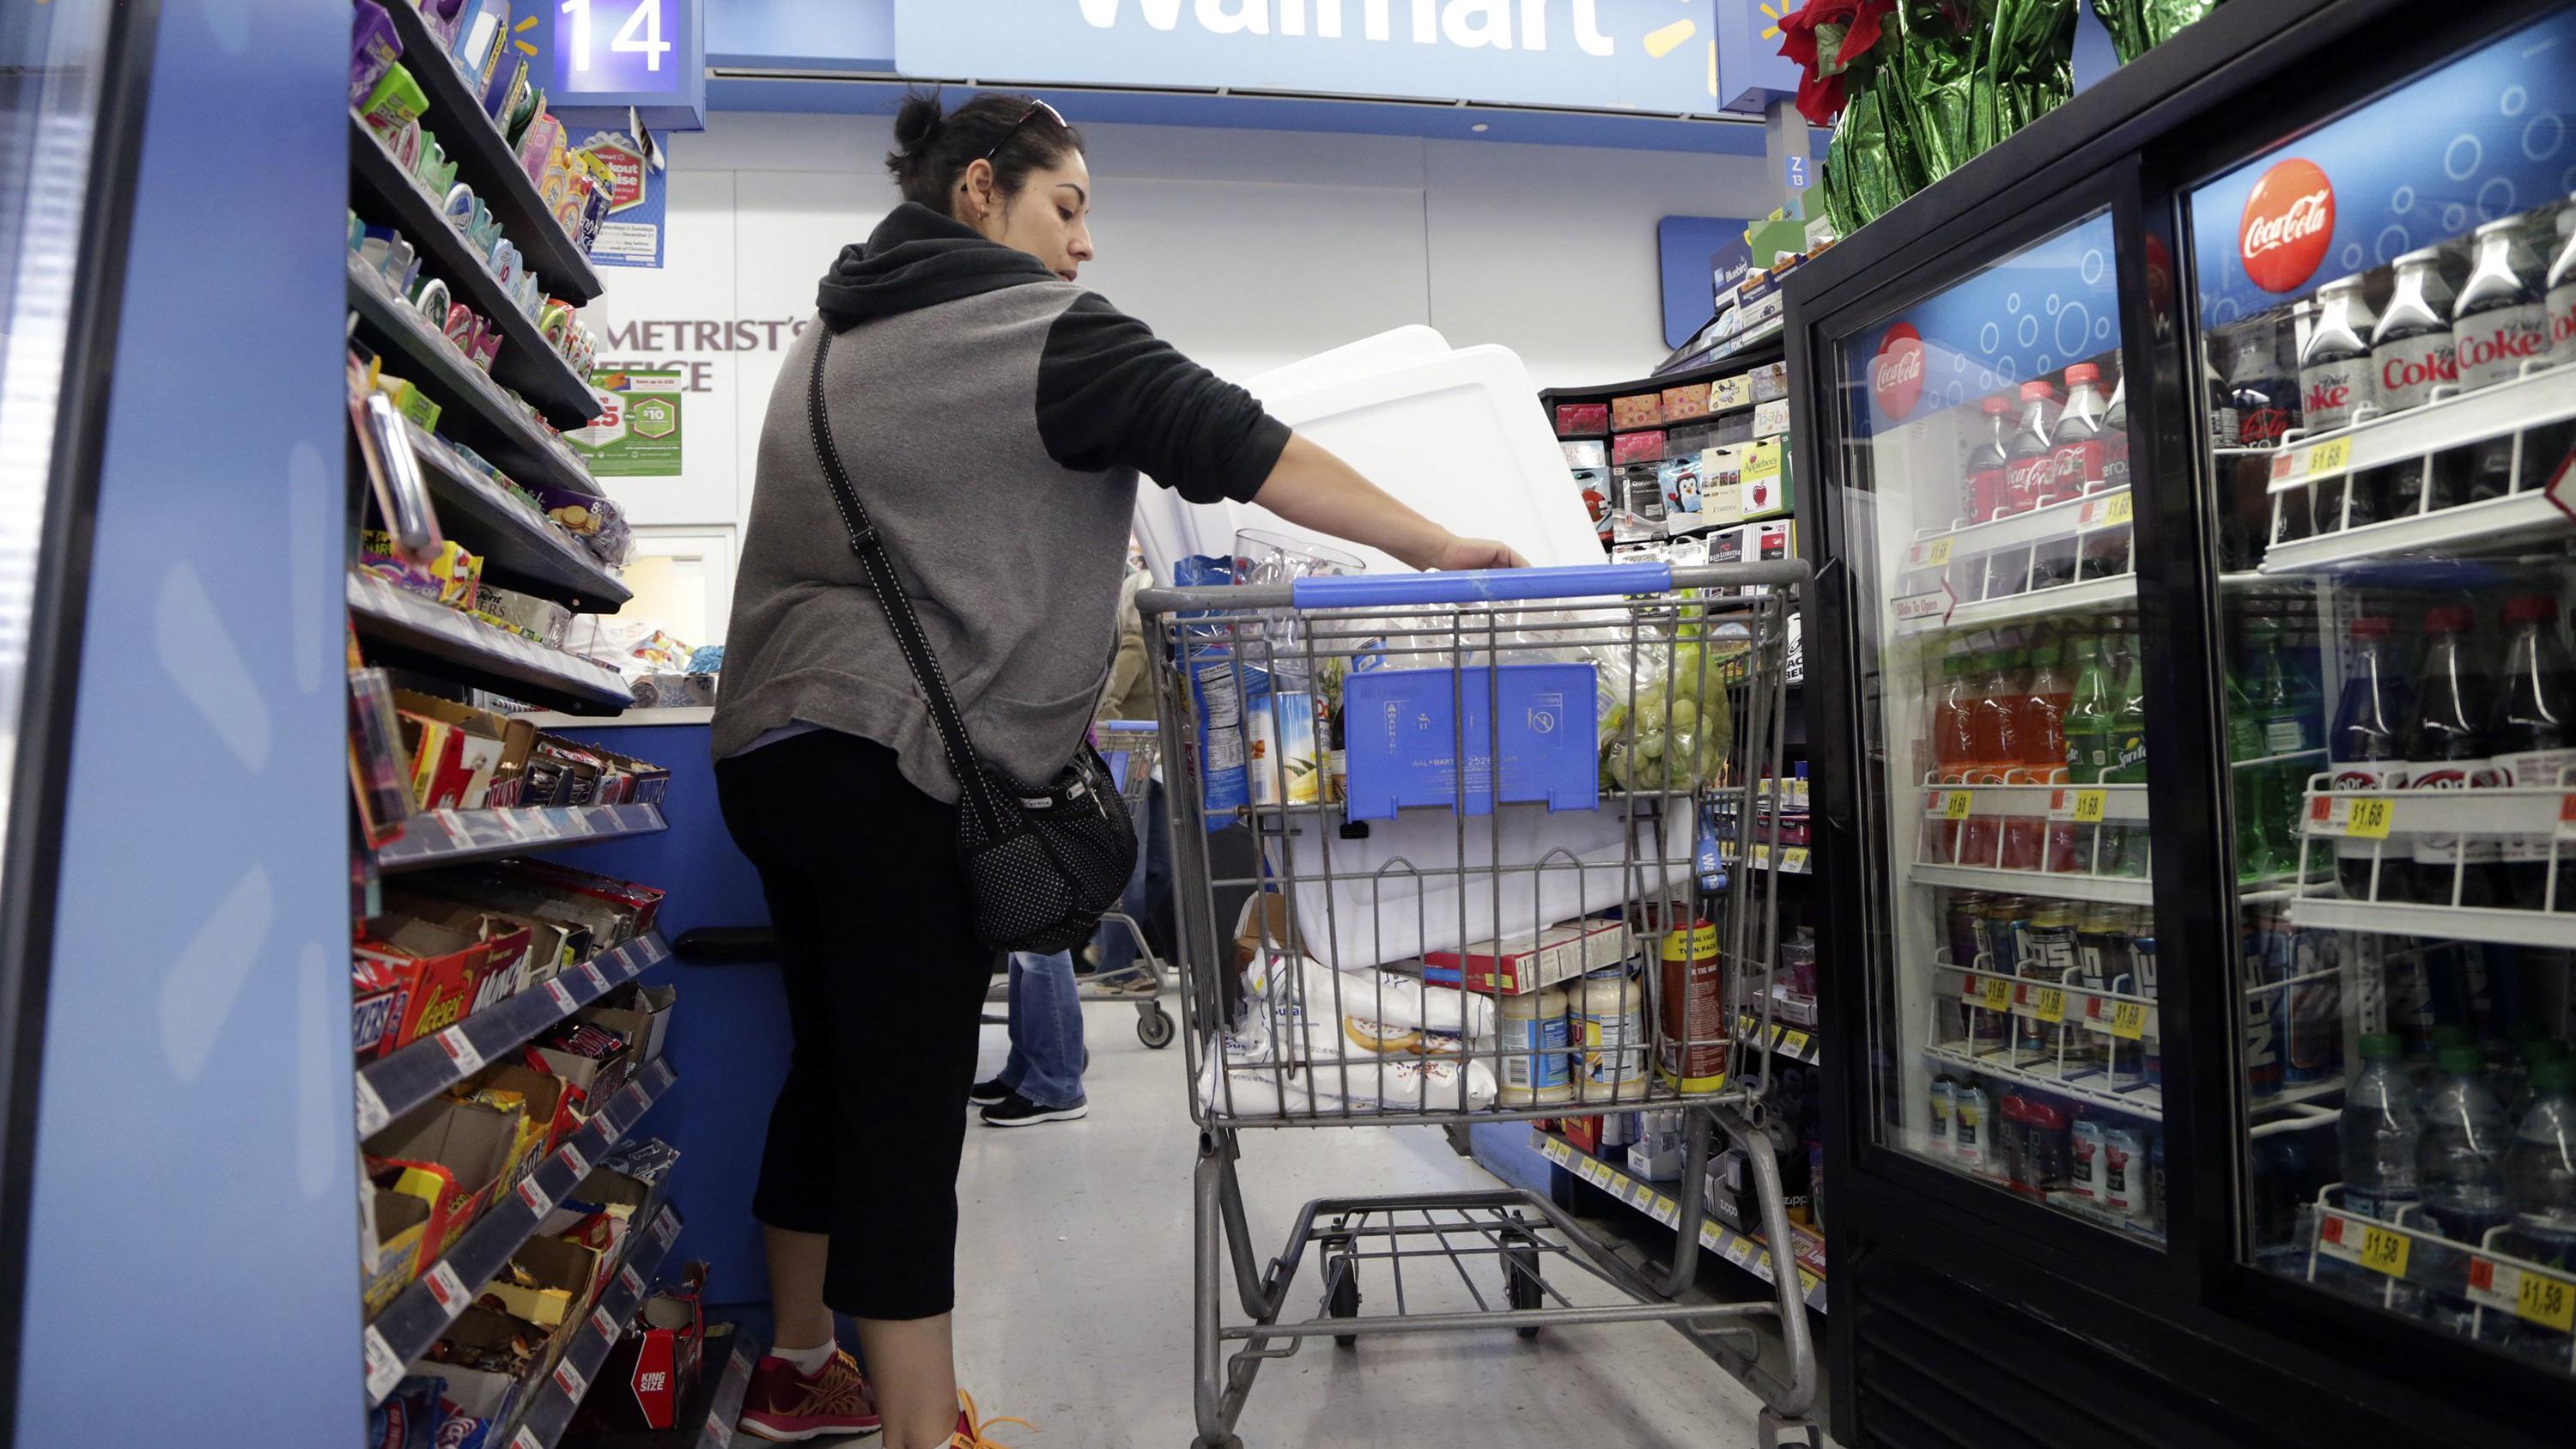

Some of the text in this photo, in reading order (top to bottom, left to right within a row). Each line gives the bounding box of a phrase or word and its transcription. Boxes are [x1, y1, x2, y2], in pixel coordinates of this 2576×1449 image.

[561, 0, 671, 71] 14
[1791, 156, 1802, 172] Z
[1792, 174, 1804, 186] 13
[1725, 260, 1747, 283] Bluebird
[2458, 330, 2543, 370] Coke
[643, 409, 665, 420] $10
[2312, 445, 2342, 468] $1.68
[1719, 550, 1741, 559] LOBSTER
[1948, 796, 1966, 814] $1.68
[2076, 796, 2098, 811] $1.68
[2353, 802, 2385, 826] $1.68
[1988, 979, 2007, 999] $1.68
[2041, 988, 2061, 1010] $1.68
[2116, 1002, 2140, 1026] $1.68
[2366, 1231, 2399, 1263] $1.58
[2523, 1278, 2563, 1314] $1.58
[640, 1380, 664, 1392] SIZE
[641, 1371, 666, 1382] KING
